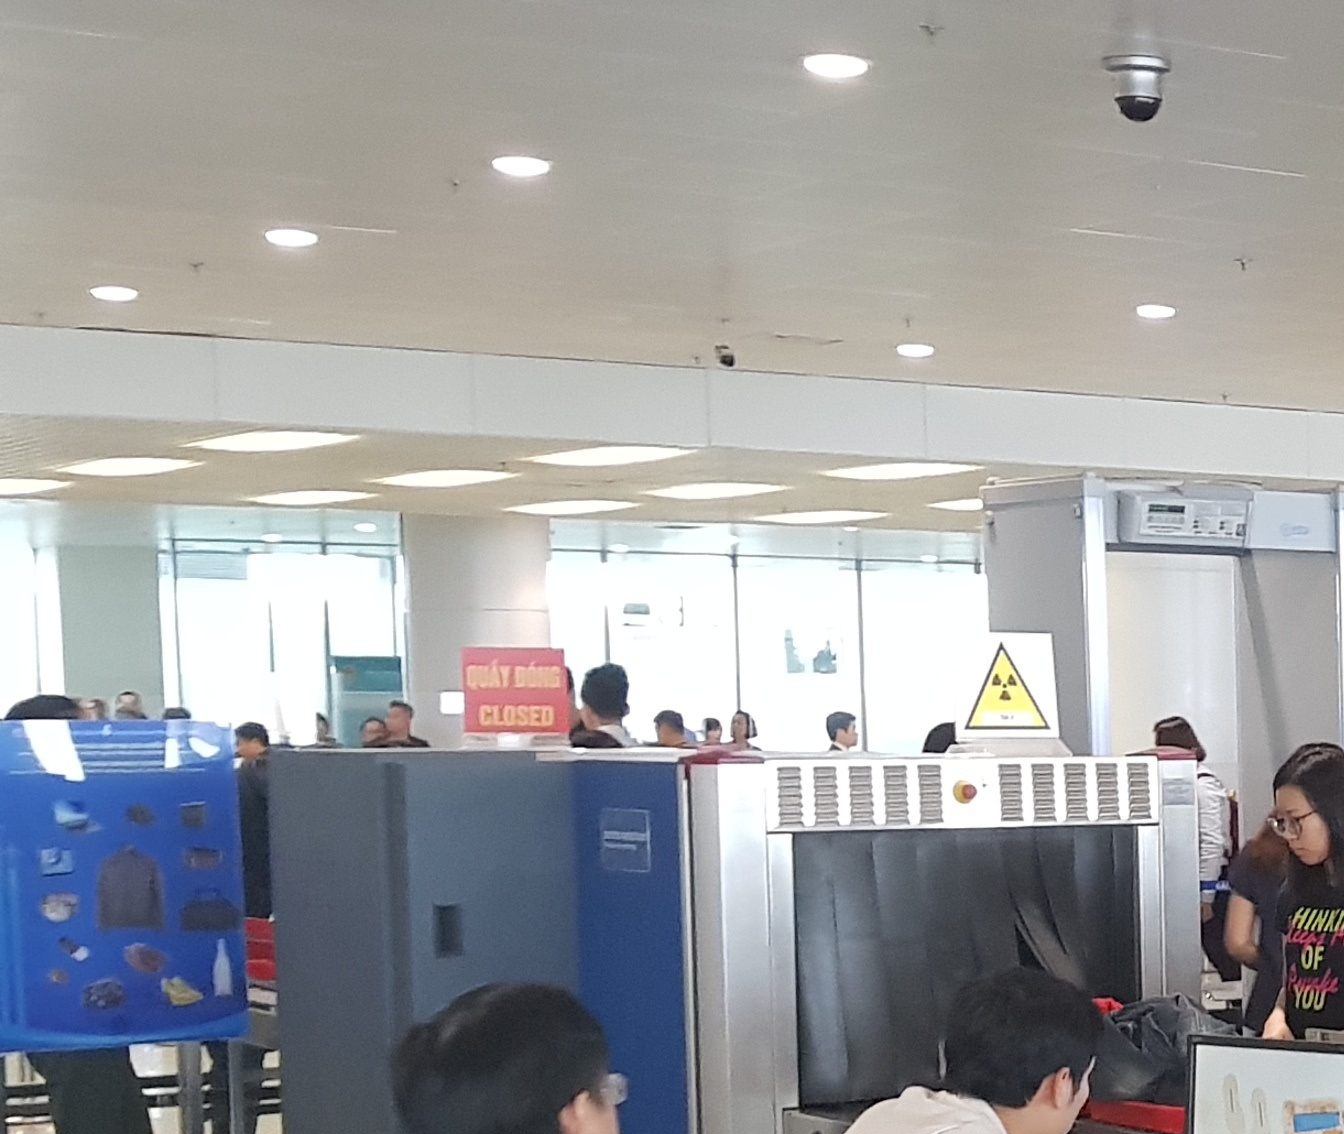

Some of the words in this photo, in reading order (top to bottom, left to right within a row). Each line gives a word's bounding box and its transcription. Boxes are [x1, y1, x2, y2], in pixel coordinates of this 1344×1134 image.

[478, 703, 555, 727] CLOSED
[1301, 944, 1325, 971] OF
[1292, 984, 1327, 1012] YOU
